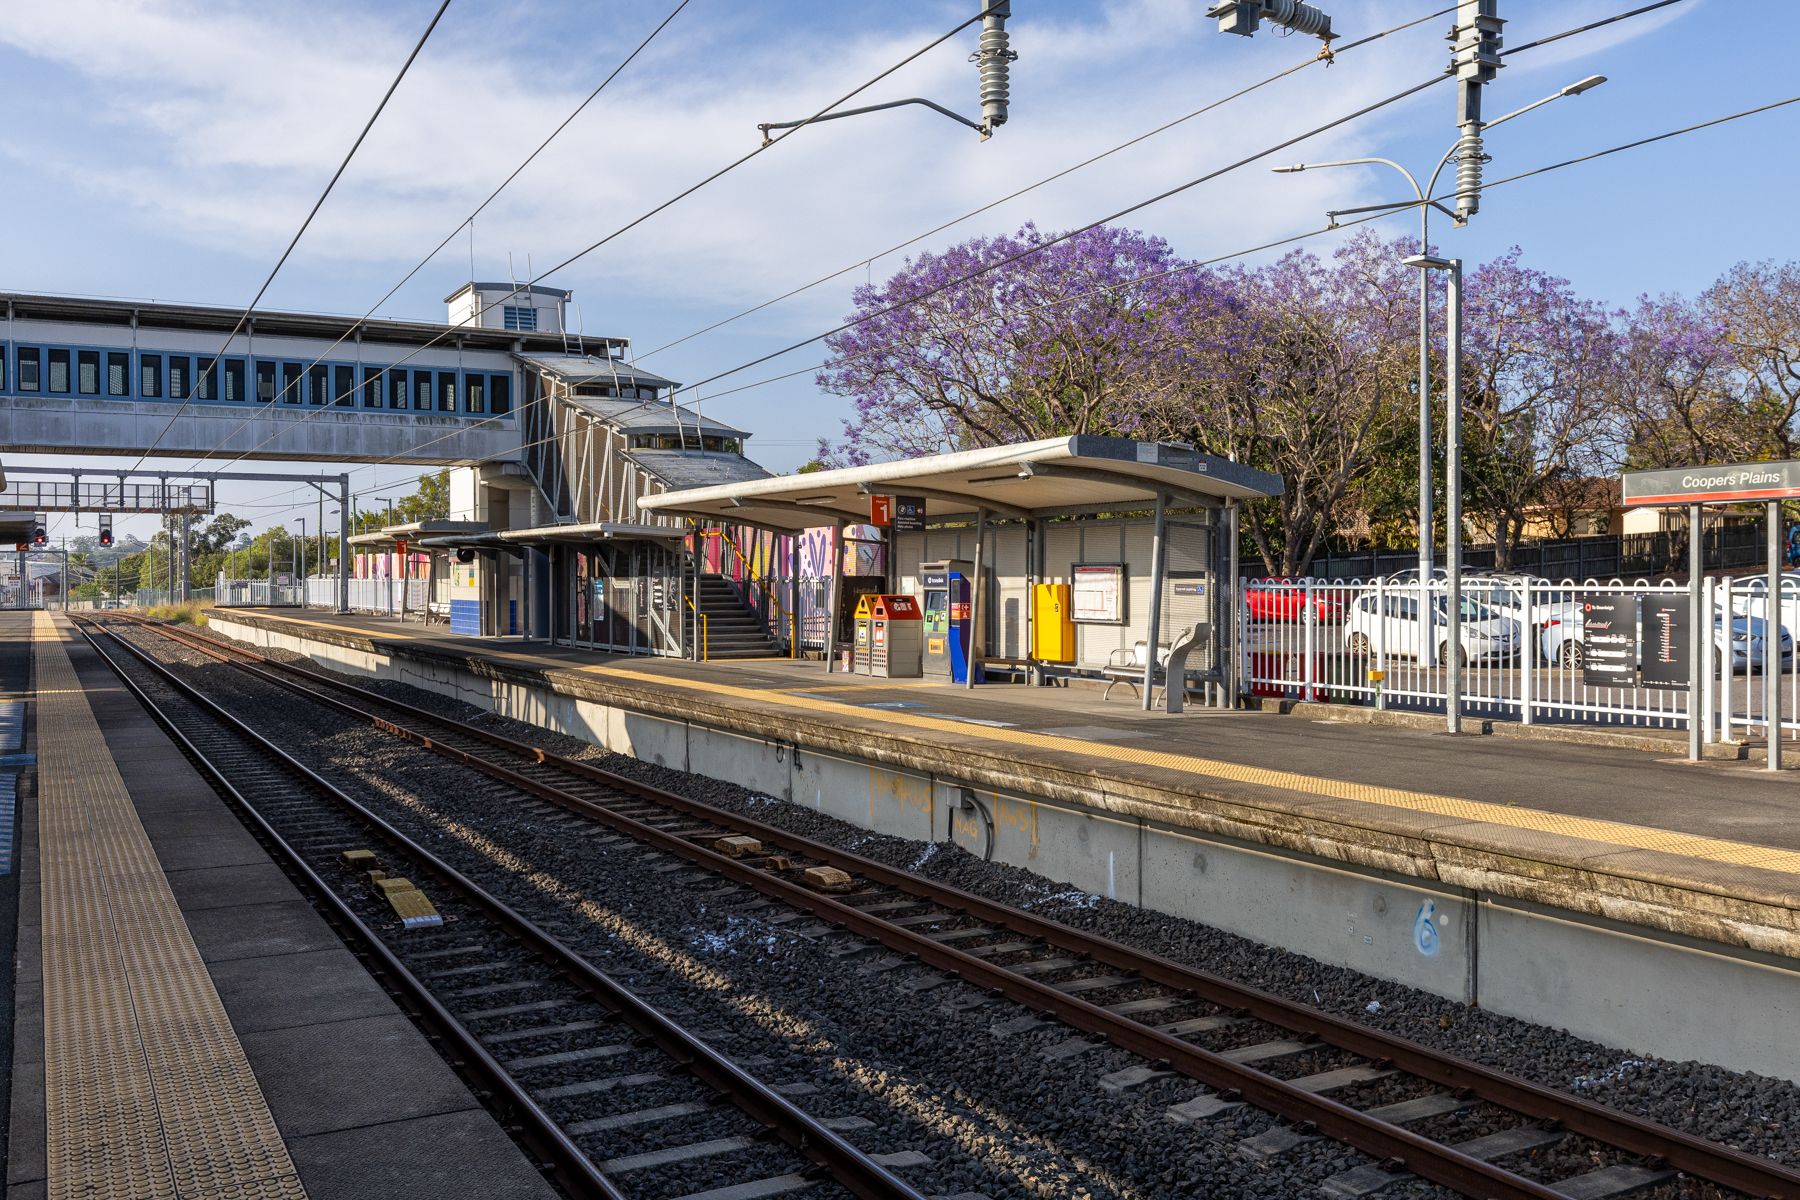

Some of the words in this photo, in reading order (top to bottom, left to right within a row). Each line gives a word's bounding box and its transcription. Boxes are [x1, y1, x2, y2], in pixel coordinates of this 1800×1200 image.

[1682, 475, 1736, 489] Coopers
[1739, 472, 1780, 485] Plains
[880, 504, 888, 522] 1
[402, 544, 406, 552] 1
